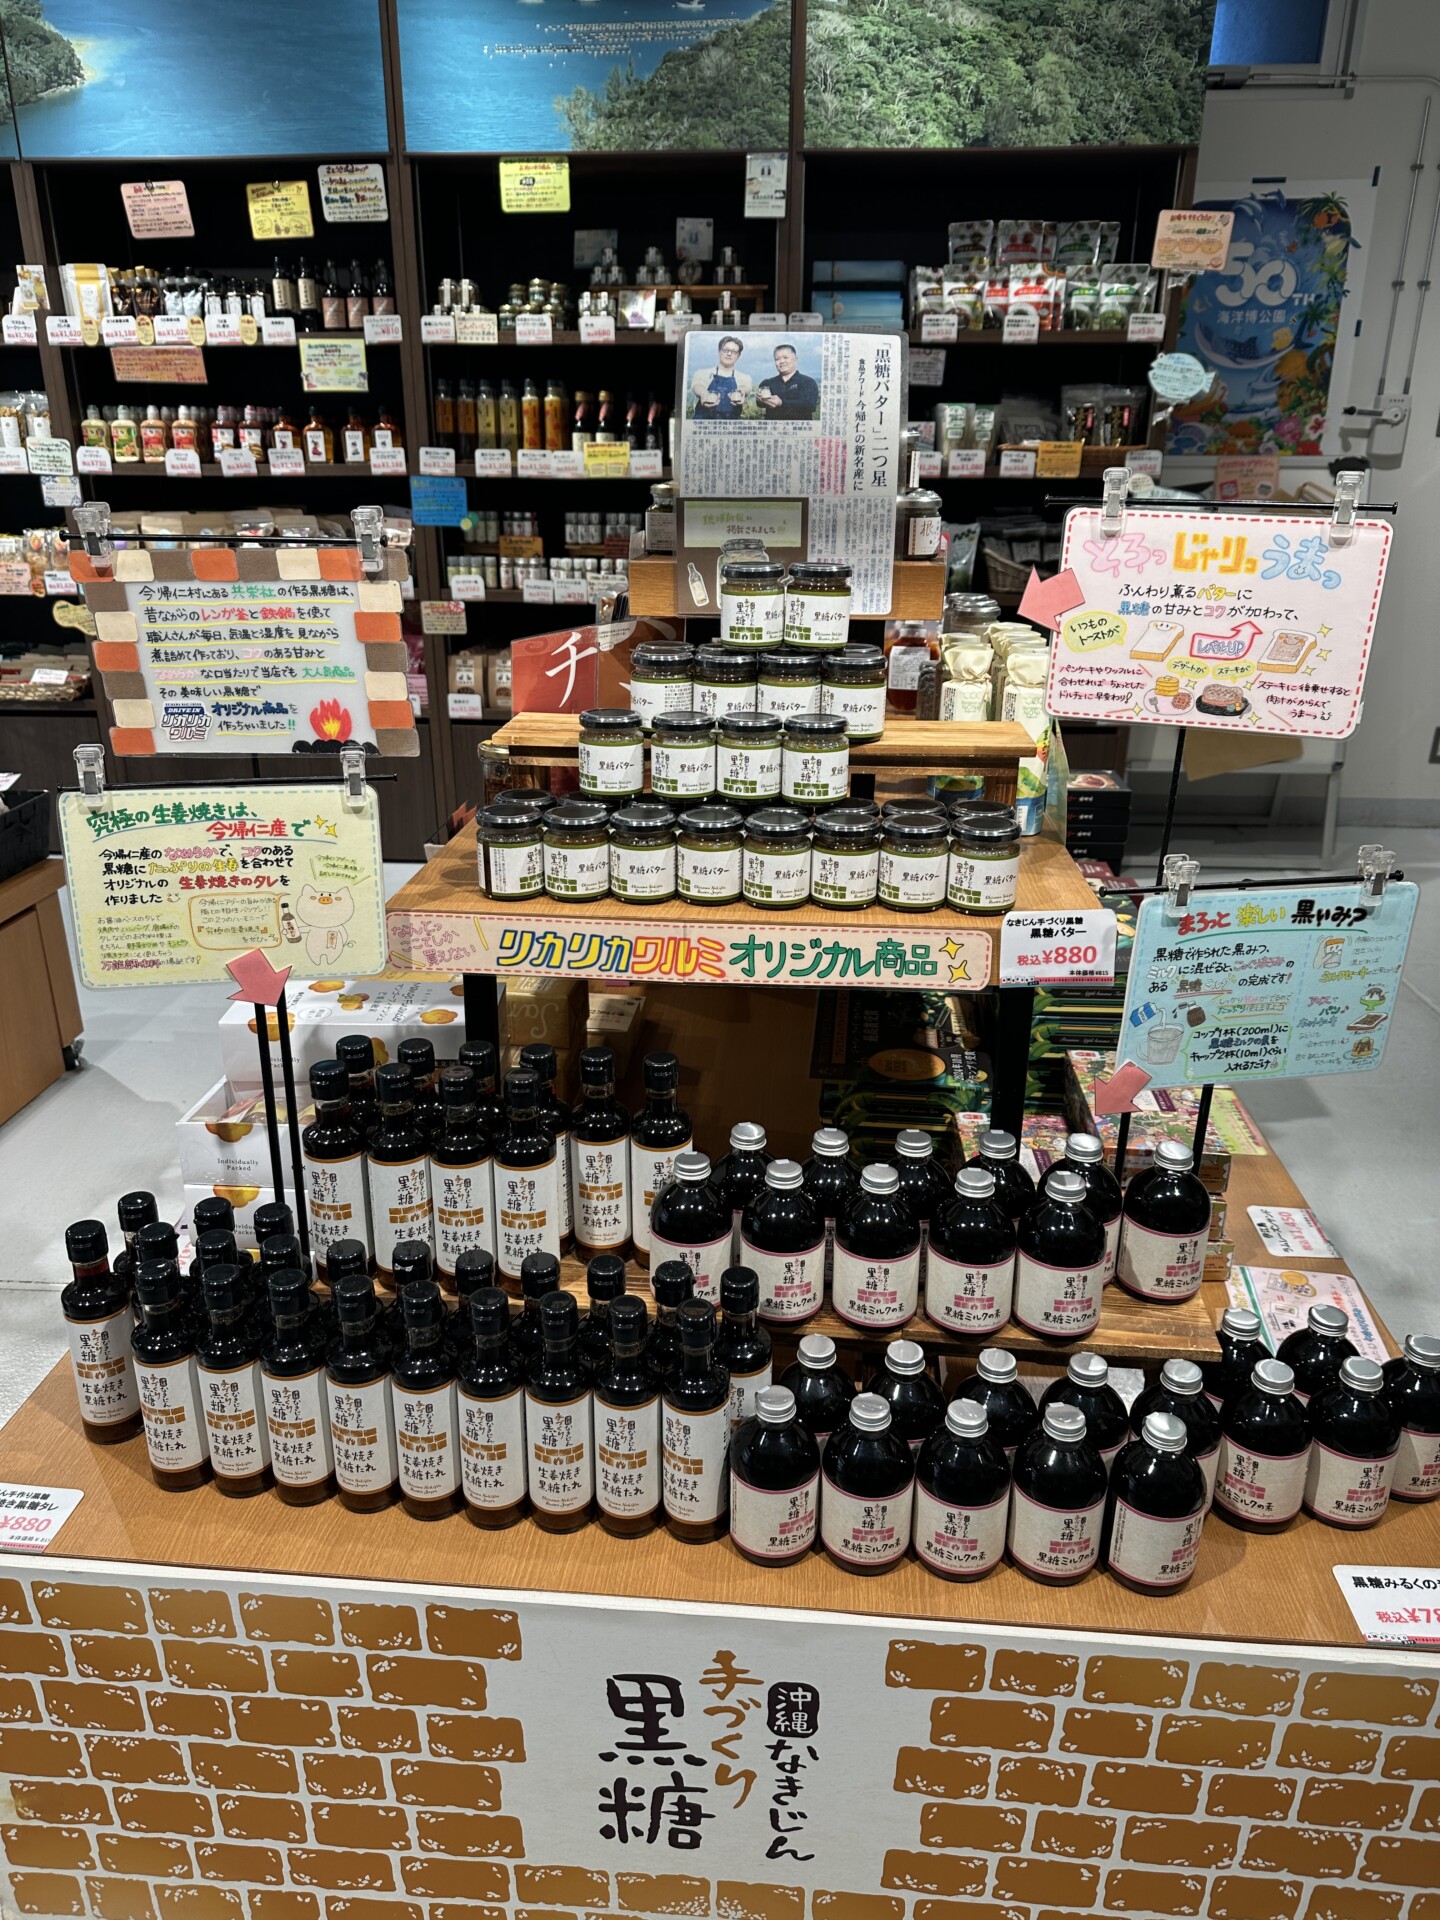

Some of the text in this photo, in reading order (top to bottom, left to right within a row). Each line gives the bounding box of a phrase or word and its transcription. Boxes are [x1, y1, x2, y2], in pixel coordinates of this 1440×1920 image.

[1217, 309, 1286, 325] 海洋博公園
[870, 341, 893, 489] 「黒糖バター」二つ星
[853, 358, 867, 491] 食品アワード 今帰仁の新名産に
[1083, 531, 1342, 590] とろっ じゃりっ うまっ
[138, 585, 355, 600] 今帰仁村にある共栄社の作る黒糖は、
[1118, 583, 1253, 601] ふんわり薫るバターに
[144, 606, 331, 622] 昔ながらのレンガ釜と鉄鍋を使って
[814, 611, 846, 622] 黒糖バター
[1118, 600, 1299, 621] 黒糖の甘みとコクが加わって、
[1070, 617, 1107, 633] いつもの
[146, 628, 340, 643] 職人さんが毎日、気温と湿度を見ながら
[1079, 624, 1121, 646] トーストが
[151, 646, 326, 663] 煮詰めて作っており、コクのある甘みと
[545, 631, 597, 708] チ
[1059, 664, 1143, 676] パンケーキやワッフルに
[211, 701, 299, 717] オリジナル商品を
[770, 701, 806, 711] 黒糖バター
[842, 702, 878, 713] 黒糖バター
[1265, 695, 1330, 709] 肉汁がからんで
[161, 714, 213, 728] リカリカ
[169, 727, 207, 741] ワルミ
[599, 761, 634, 771] 黒糖バター
[679, 763, 713, 774] 黒糖バター
[801, 758, 812, 782] 黒糖
[87, 802, 259, 837] 究極の生姜焼きは、
[206, 818, 311, 840] 今帰仁産で
[102, 857, 293, 876] 黒糖にたっぷりの生姜を合わせて
[551, 854, 560, 877] 黒糖
[578, 860, 610, 873] 黒糖バター
[628, 864, 666, 875] 黒糖バター
[692, 865, 730, 876] 黒糖バター
[179, 874, 290, 890] 生姜焼きのタレを
[902, 871, 940, 882] 黒糖バター
[984, 874, 1017, 886] 黒糖バター
[105, 892, 163, 906] 作りました
[1006, 917, 1083, 926] なきじん手づくり黒糖
[1177, 911, 1232, 936] まろっと
[1236, 903, 1287, 928] 楽しい
[1030, 927, 1087, 938] 黒糖バター
[401, 931, 460, 953] ここでしか
[423, 944, 477, 966] 買えない
[1153, 943, 1270, 962] 黒糖で作られた黒みつ、
[1224, 1059, 1271, 1072] 入れるだけ
[217, 1158, 259, 1166] Individually
[586, 1154, 599, 1185] 黒糖
[312, 1171, 326, 1202] 黒糖
[582, 1203, 622, 1217] 生姜焼き
[313, 1221, 350, 1237] 生姜焼き
[582, 1215, 622, 1229] 黒糖たれ
[441, 1229, 482, 1244] 生姜焼き
[504, 1231, 544, 1247] 生姜焼き
[80, 1334, 97, 1362] 黒糖
[82, 1379, 125, 1395] 生姜焼き
[84, 1391, 127, 1406] 黒糖たれ
[210, 1382, 226, 1413] 黒糖
[146, 1428, 183, 1440] 生姜焼き
[211, 1432, 253, 1446] 生姜焼き
[147, 1438, 187, 1451] 黒糖たれ
[213, 1446, 256, 1459] 黒糖たれ
[273, 1440, 314, 1454] 生姜焼き
[274, 1454, 316, 1467] 黒糖たれ
[335, 1445, 375, 1461] 生姜焼き
[337, 1460, 377, 1474] 黒糖たれ
[464, 1458, 503, 1475] 生姜焼き
[539, 1467, 580, 1481] 生姜焼き
[465, 1472, 504, 1488] 黒糖たれ
[602, 1468, 643, 1484] 生姜焼き
[0, 1489, 51, 1500] ん手作り黒糖
[539, 1480, 582, 1494] 黒糖たれ
[602, 1481, 644, 1497] 黒糖たれ
[1352, 1576, 1440, 1590] 黒糖みるくの
[698, 1650, 765, 1809] 手づくり
[598, 1673, 716, 1849] 黒糖
[764, 1686, 819, 1861] 沖縄 なきじん
